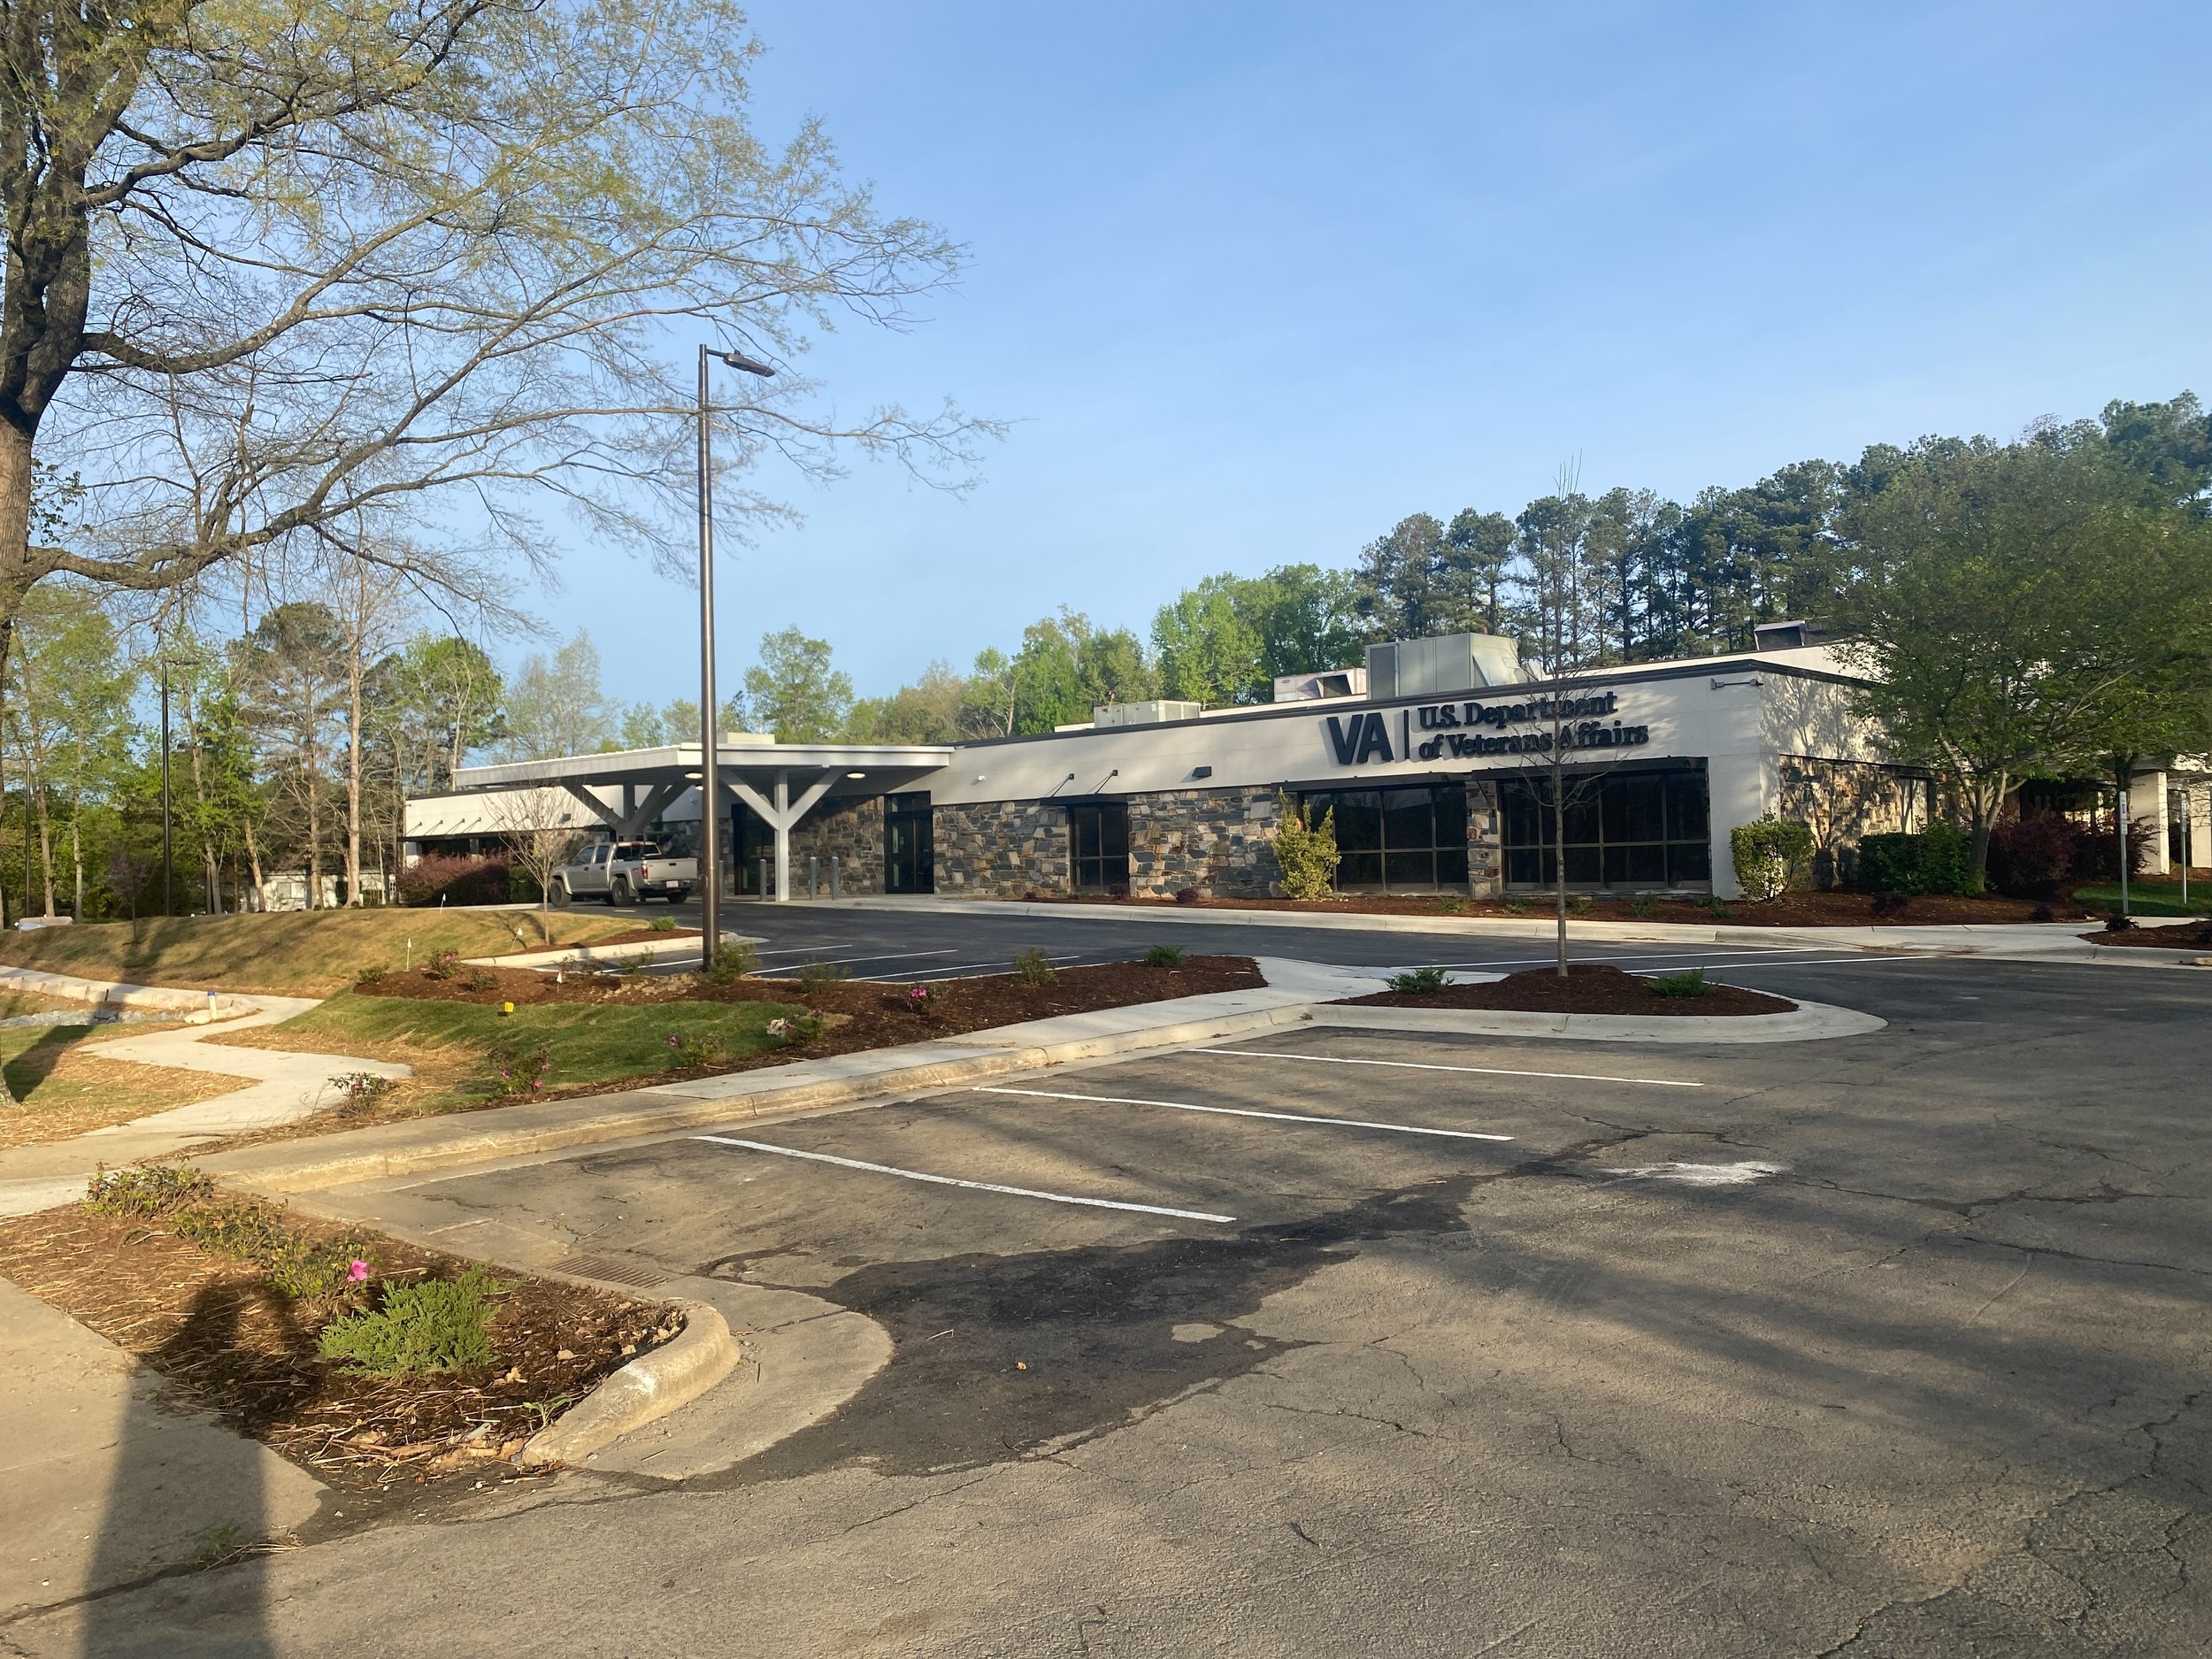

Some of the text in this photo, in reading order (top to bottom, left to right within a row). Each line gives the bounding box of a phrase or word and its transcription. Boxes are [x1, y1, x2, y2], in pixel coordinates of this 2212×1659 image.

[1417, 691, 1618, 729] U.S. Department
[1326, 712, 1394, 764] VA
[1418, 720, 1649, 759] of Veterans Affairs
